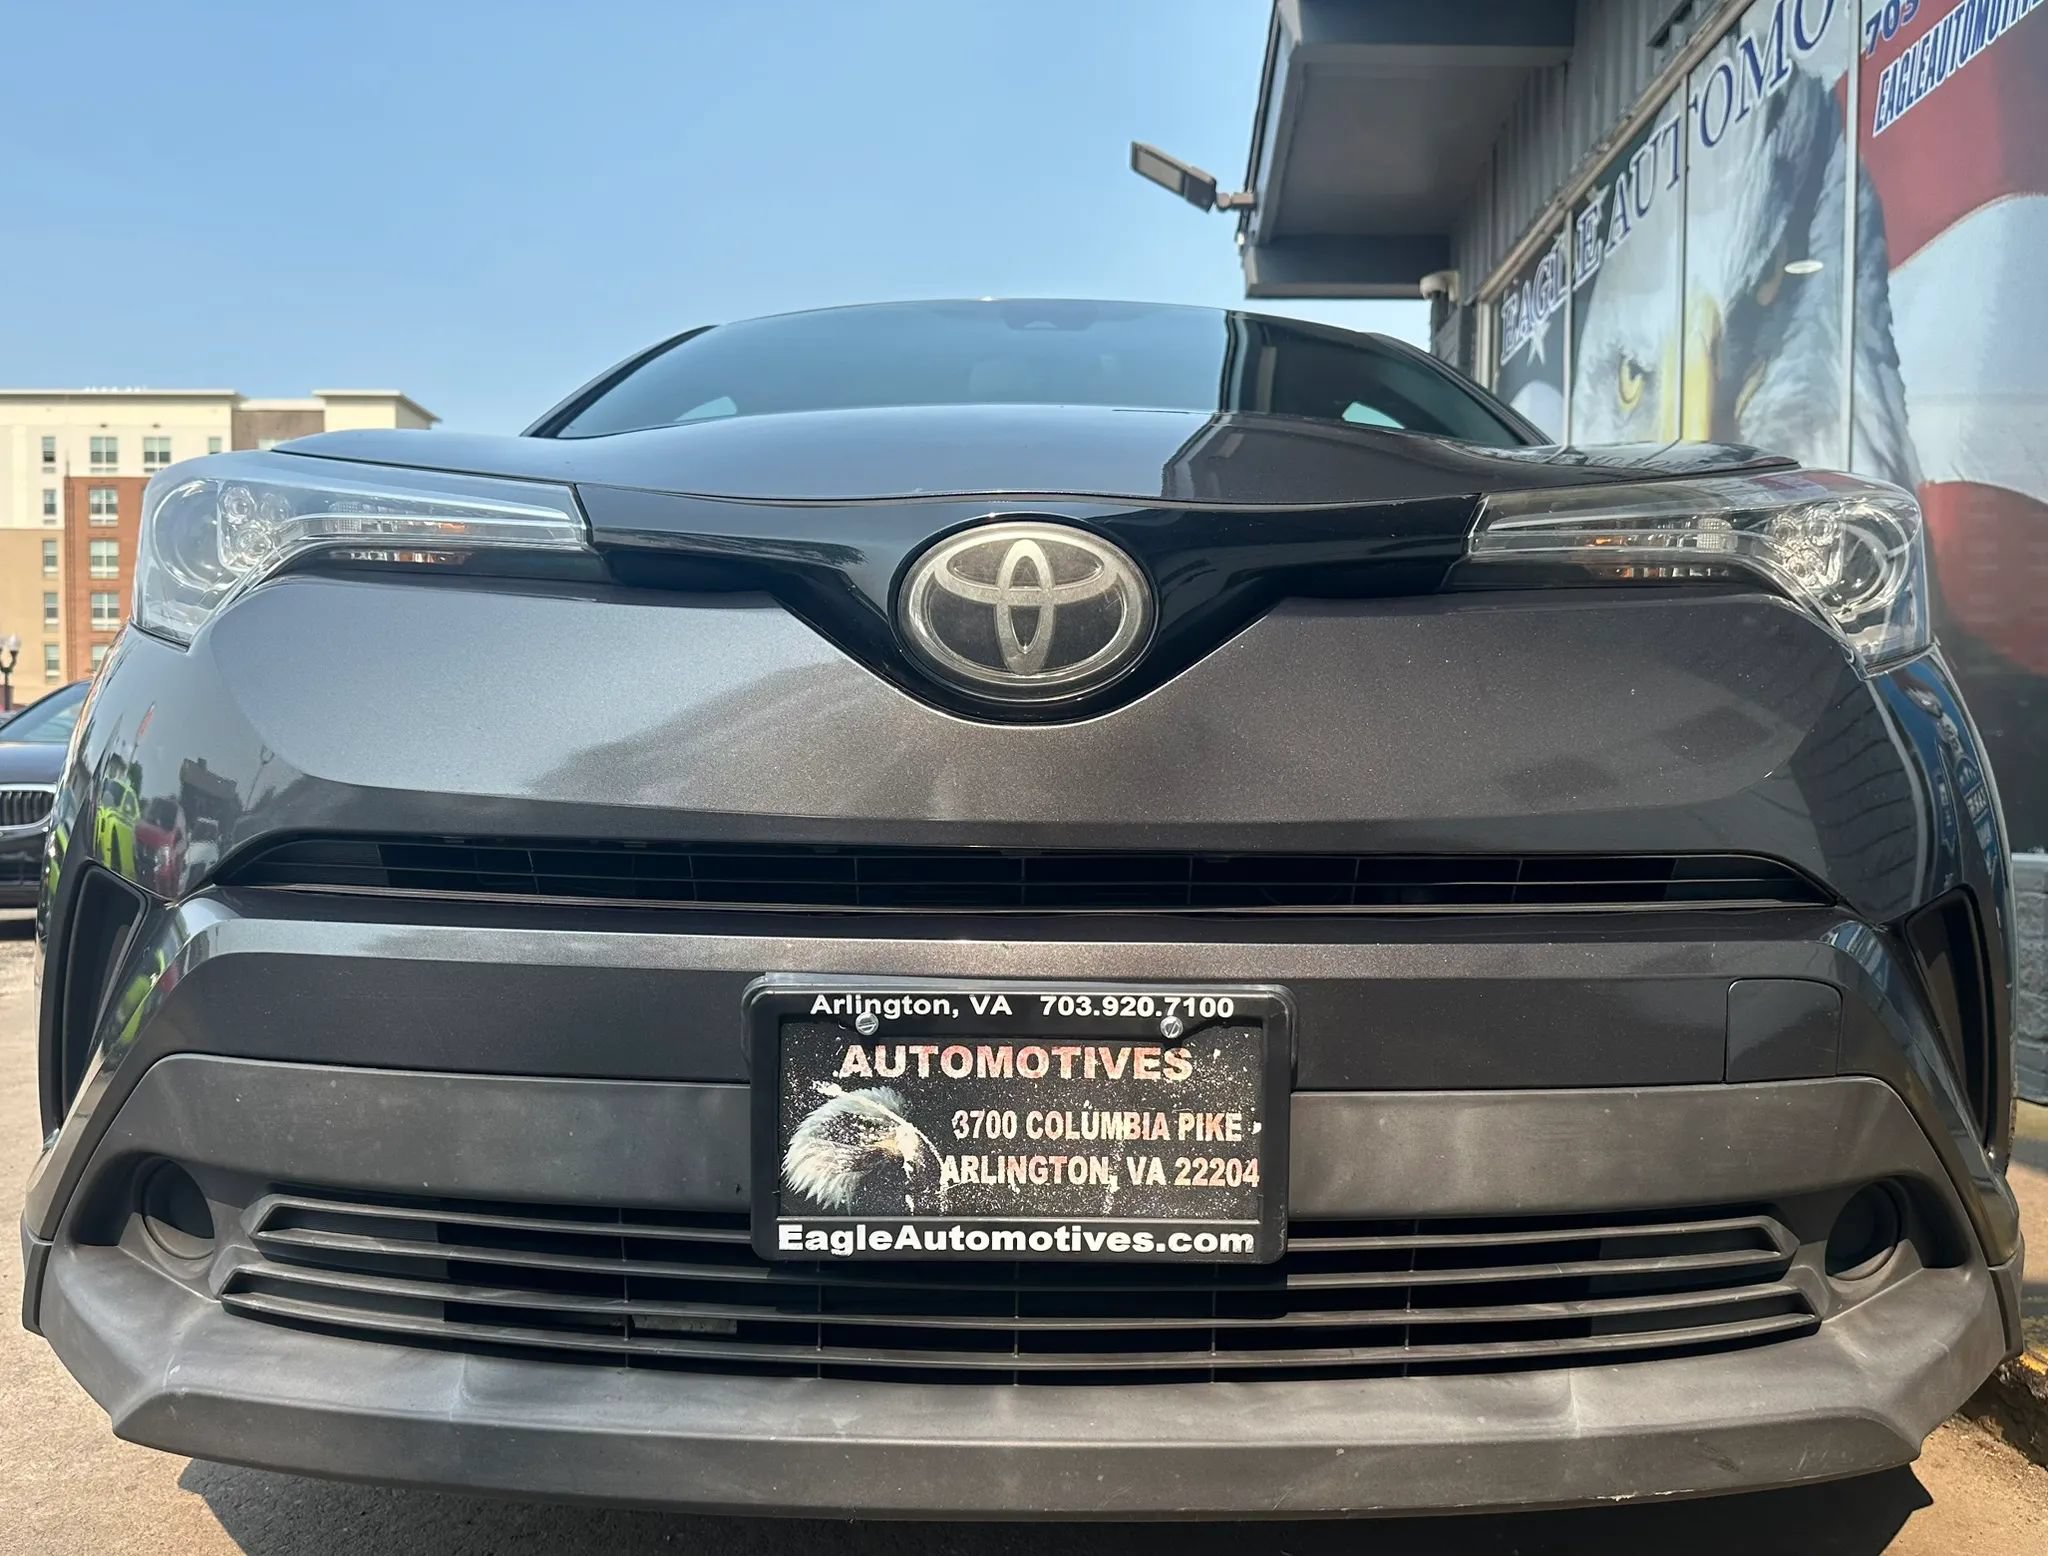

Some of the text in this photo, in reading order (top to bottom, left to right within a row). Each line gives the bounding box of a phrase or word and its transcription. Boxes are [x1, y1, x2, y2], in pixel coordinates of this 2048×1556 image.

[1501, 196, 1602, 365] EAGLE
[810, 995, 1235, 1020] Arlington, VA 703.920.7100
[839, 1044, 1193, 1080] AUTOMOTIVES
[952, 1110, 1242, 1142] 3700 COLUMBIA PIKE
[1127, 1157, 1167, 1186] VA
[1174, 1158, 1261, 1189] 22204
[778, 1224, 1255, 1258] EagleAutomotives.com
